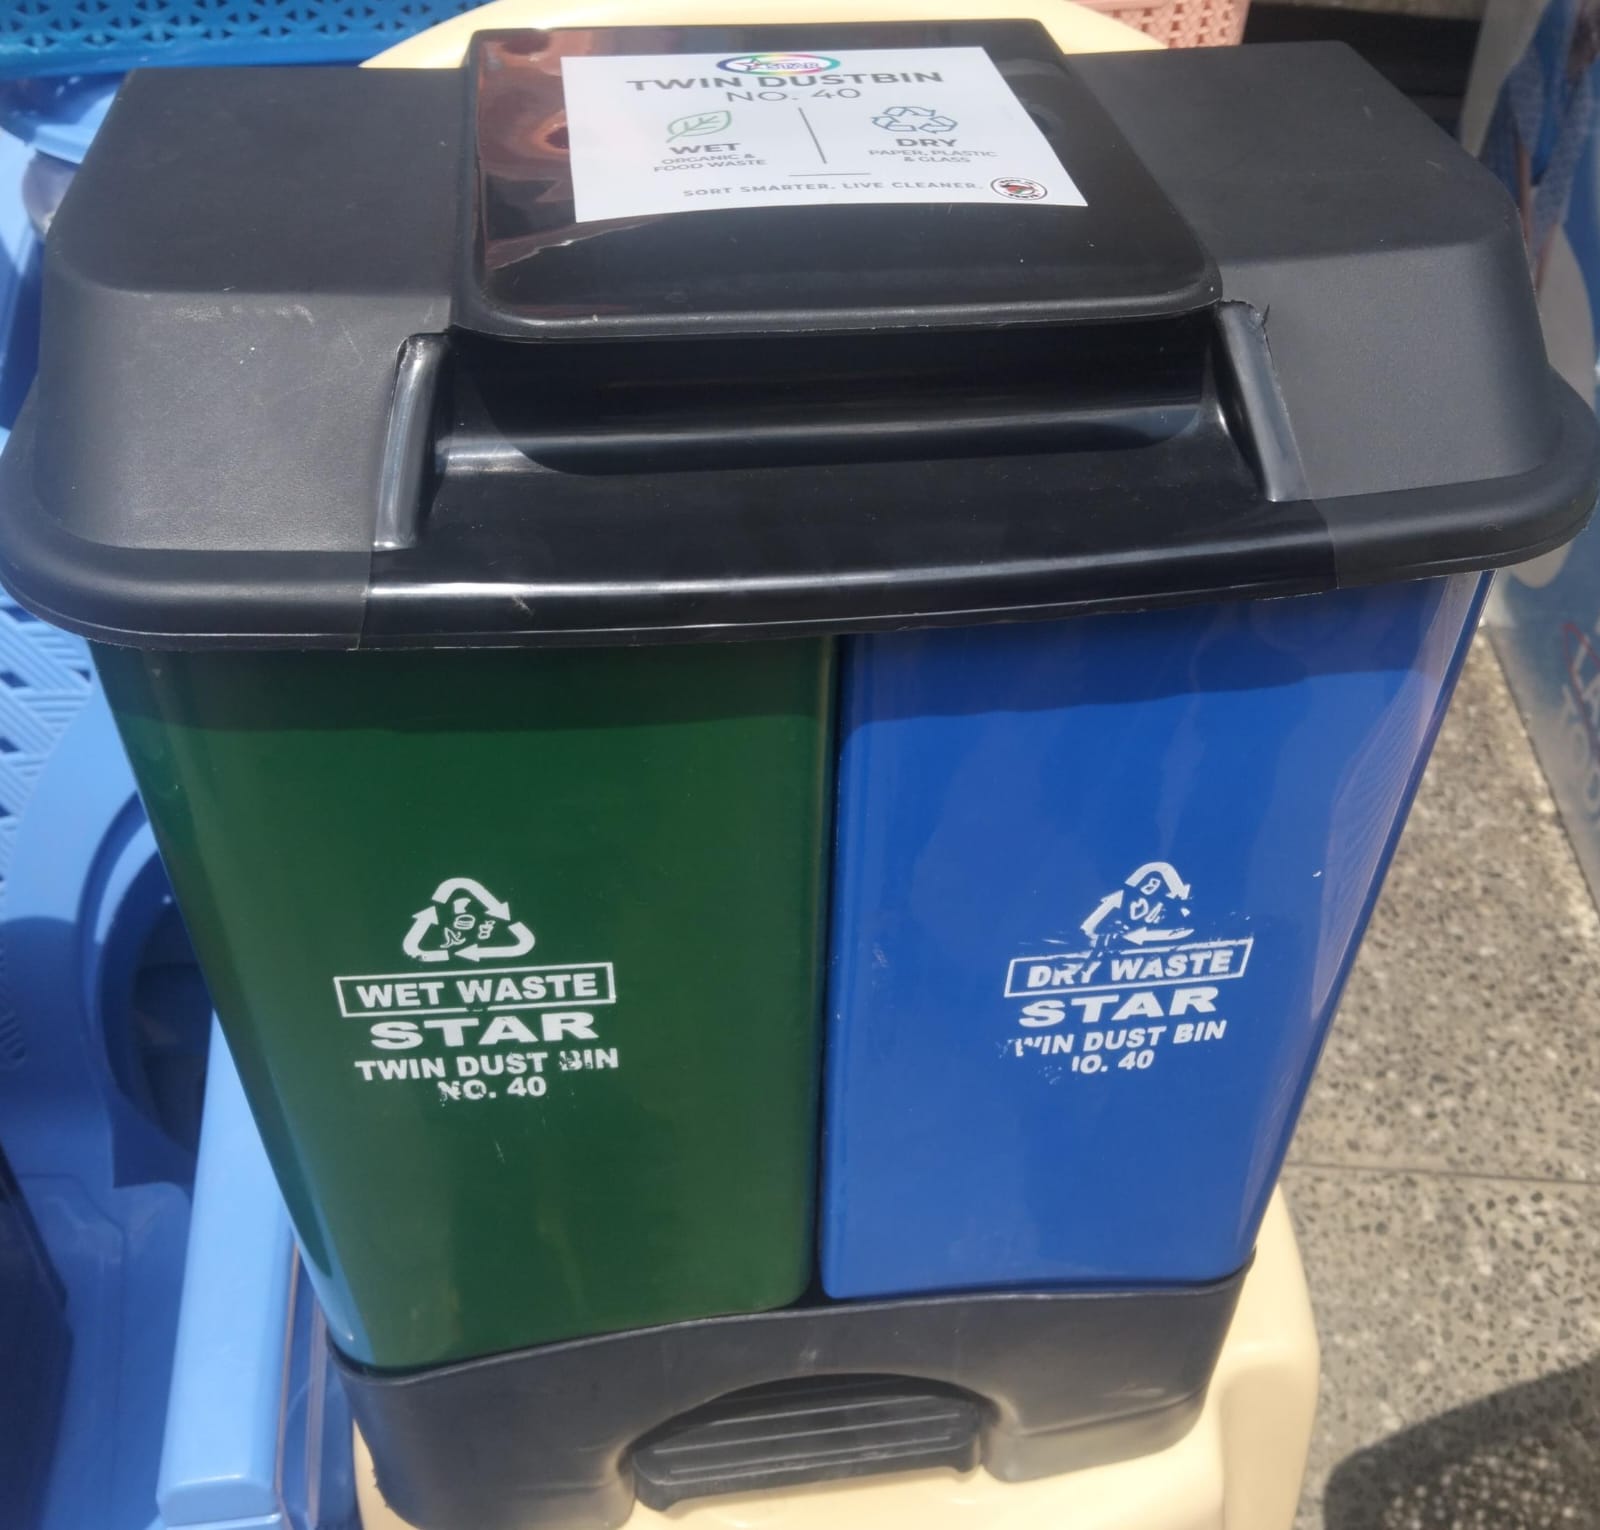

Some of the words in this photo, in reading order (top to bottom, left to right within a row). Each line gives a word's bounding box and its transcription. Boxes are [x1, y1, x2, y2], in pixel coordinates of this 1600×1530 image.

[626, 77, 742, 90] TWIN
[757, 71, 943, 88] DUSTBIN
[726, 91, 799, 102] NO.
[812, 88, 861, 99] 40
[669, 142, 741, 155] WET
[896, 138, 957, 148] DRY
[653, 163, 704, 172] FOOD
[706, 159, 768, 168] WASTE
[682, 187, 733, 197] SORT
[739, 183, 835, 193] SMARTER.
[1027, 959, 1102, 988] DRY
[1110, 949, 1235, 982] WASTE
[356, 981, 444, 1009] WET
[456, 972, 599, 1004] WASTE
[1018, 986, 1219, 1028] STAR
[370, 1011, 599, 1050] STAR
[1082, 1025, 1168, 1053] DUST
[1172, 1019, 1228, 1044] BIN
[354, 1056, 447, 1081] TWIN
[456, 1051, 549, 1077] DUST
[559, 1047, 619, 1071] BIN
[1117, 1049, 1156, 1071] 40
[437, 1080, 498, 1101] NO.
[507, 1076, 548, 1098] 40
